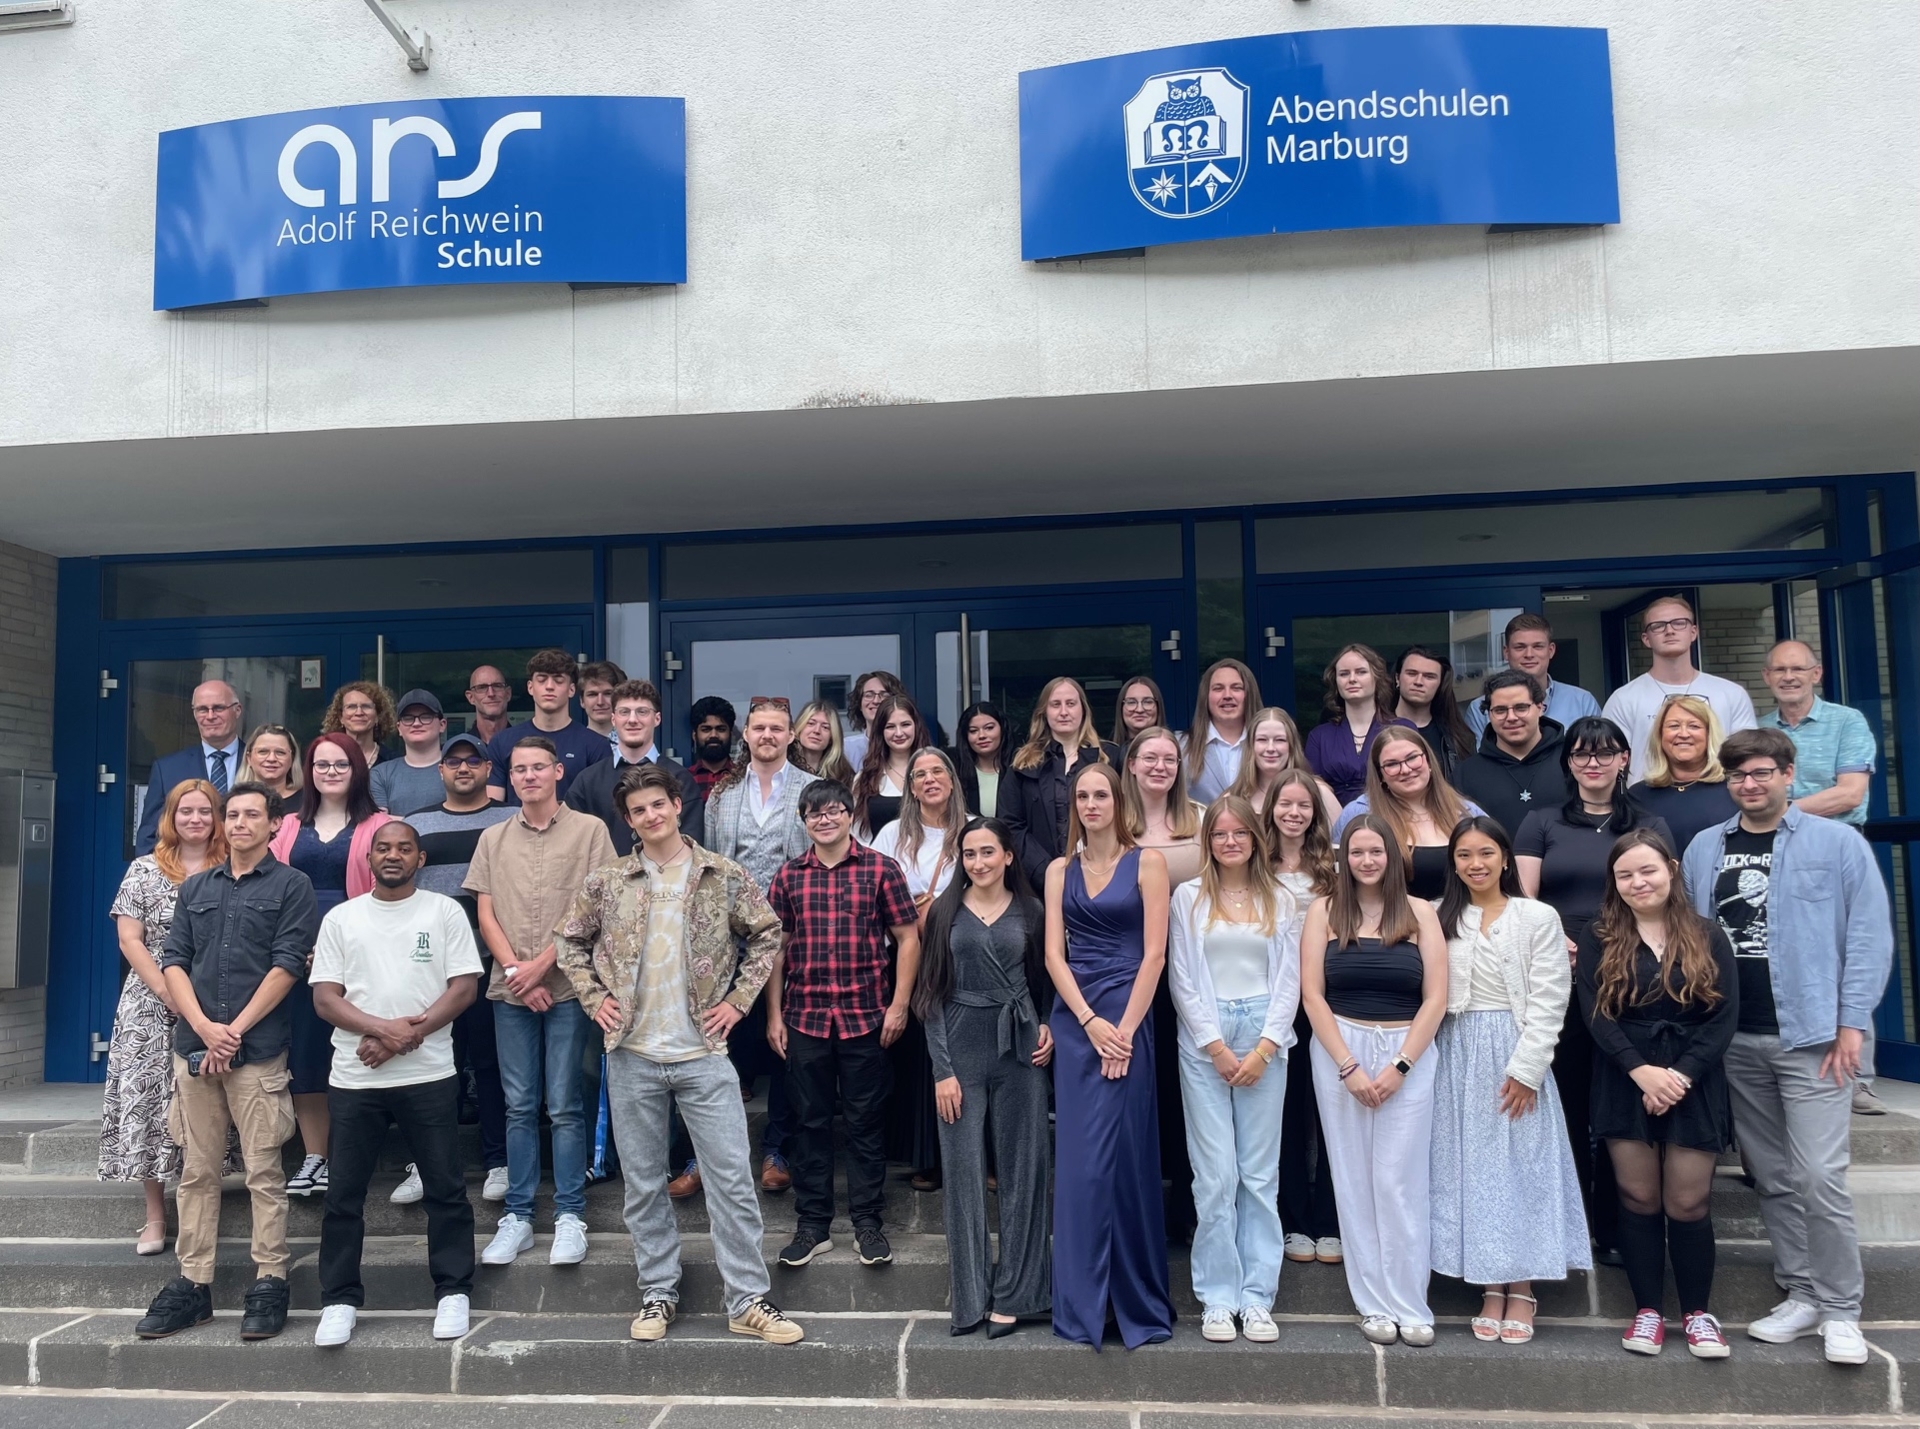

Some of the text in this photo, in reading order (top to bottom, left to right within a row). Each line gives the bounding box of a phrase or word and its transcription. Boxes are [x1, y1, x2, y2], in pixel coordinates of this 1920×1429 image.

[1267, 88, 1509, 125] Abendschulen
[1267, 131, 1409, 164] Marburg
[276, 204, 543, 247] Adolf Reichwein
[437, 239, 542, 269] Schule
[1723, 853, 1750, 868] OCK
